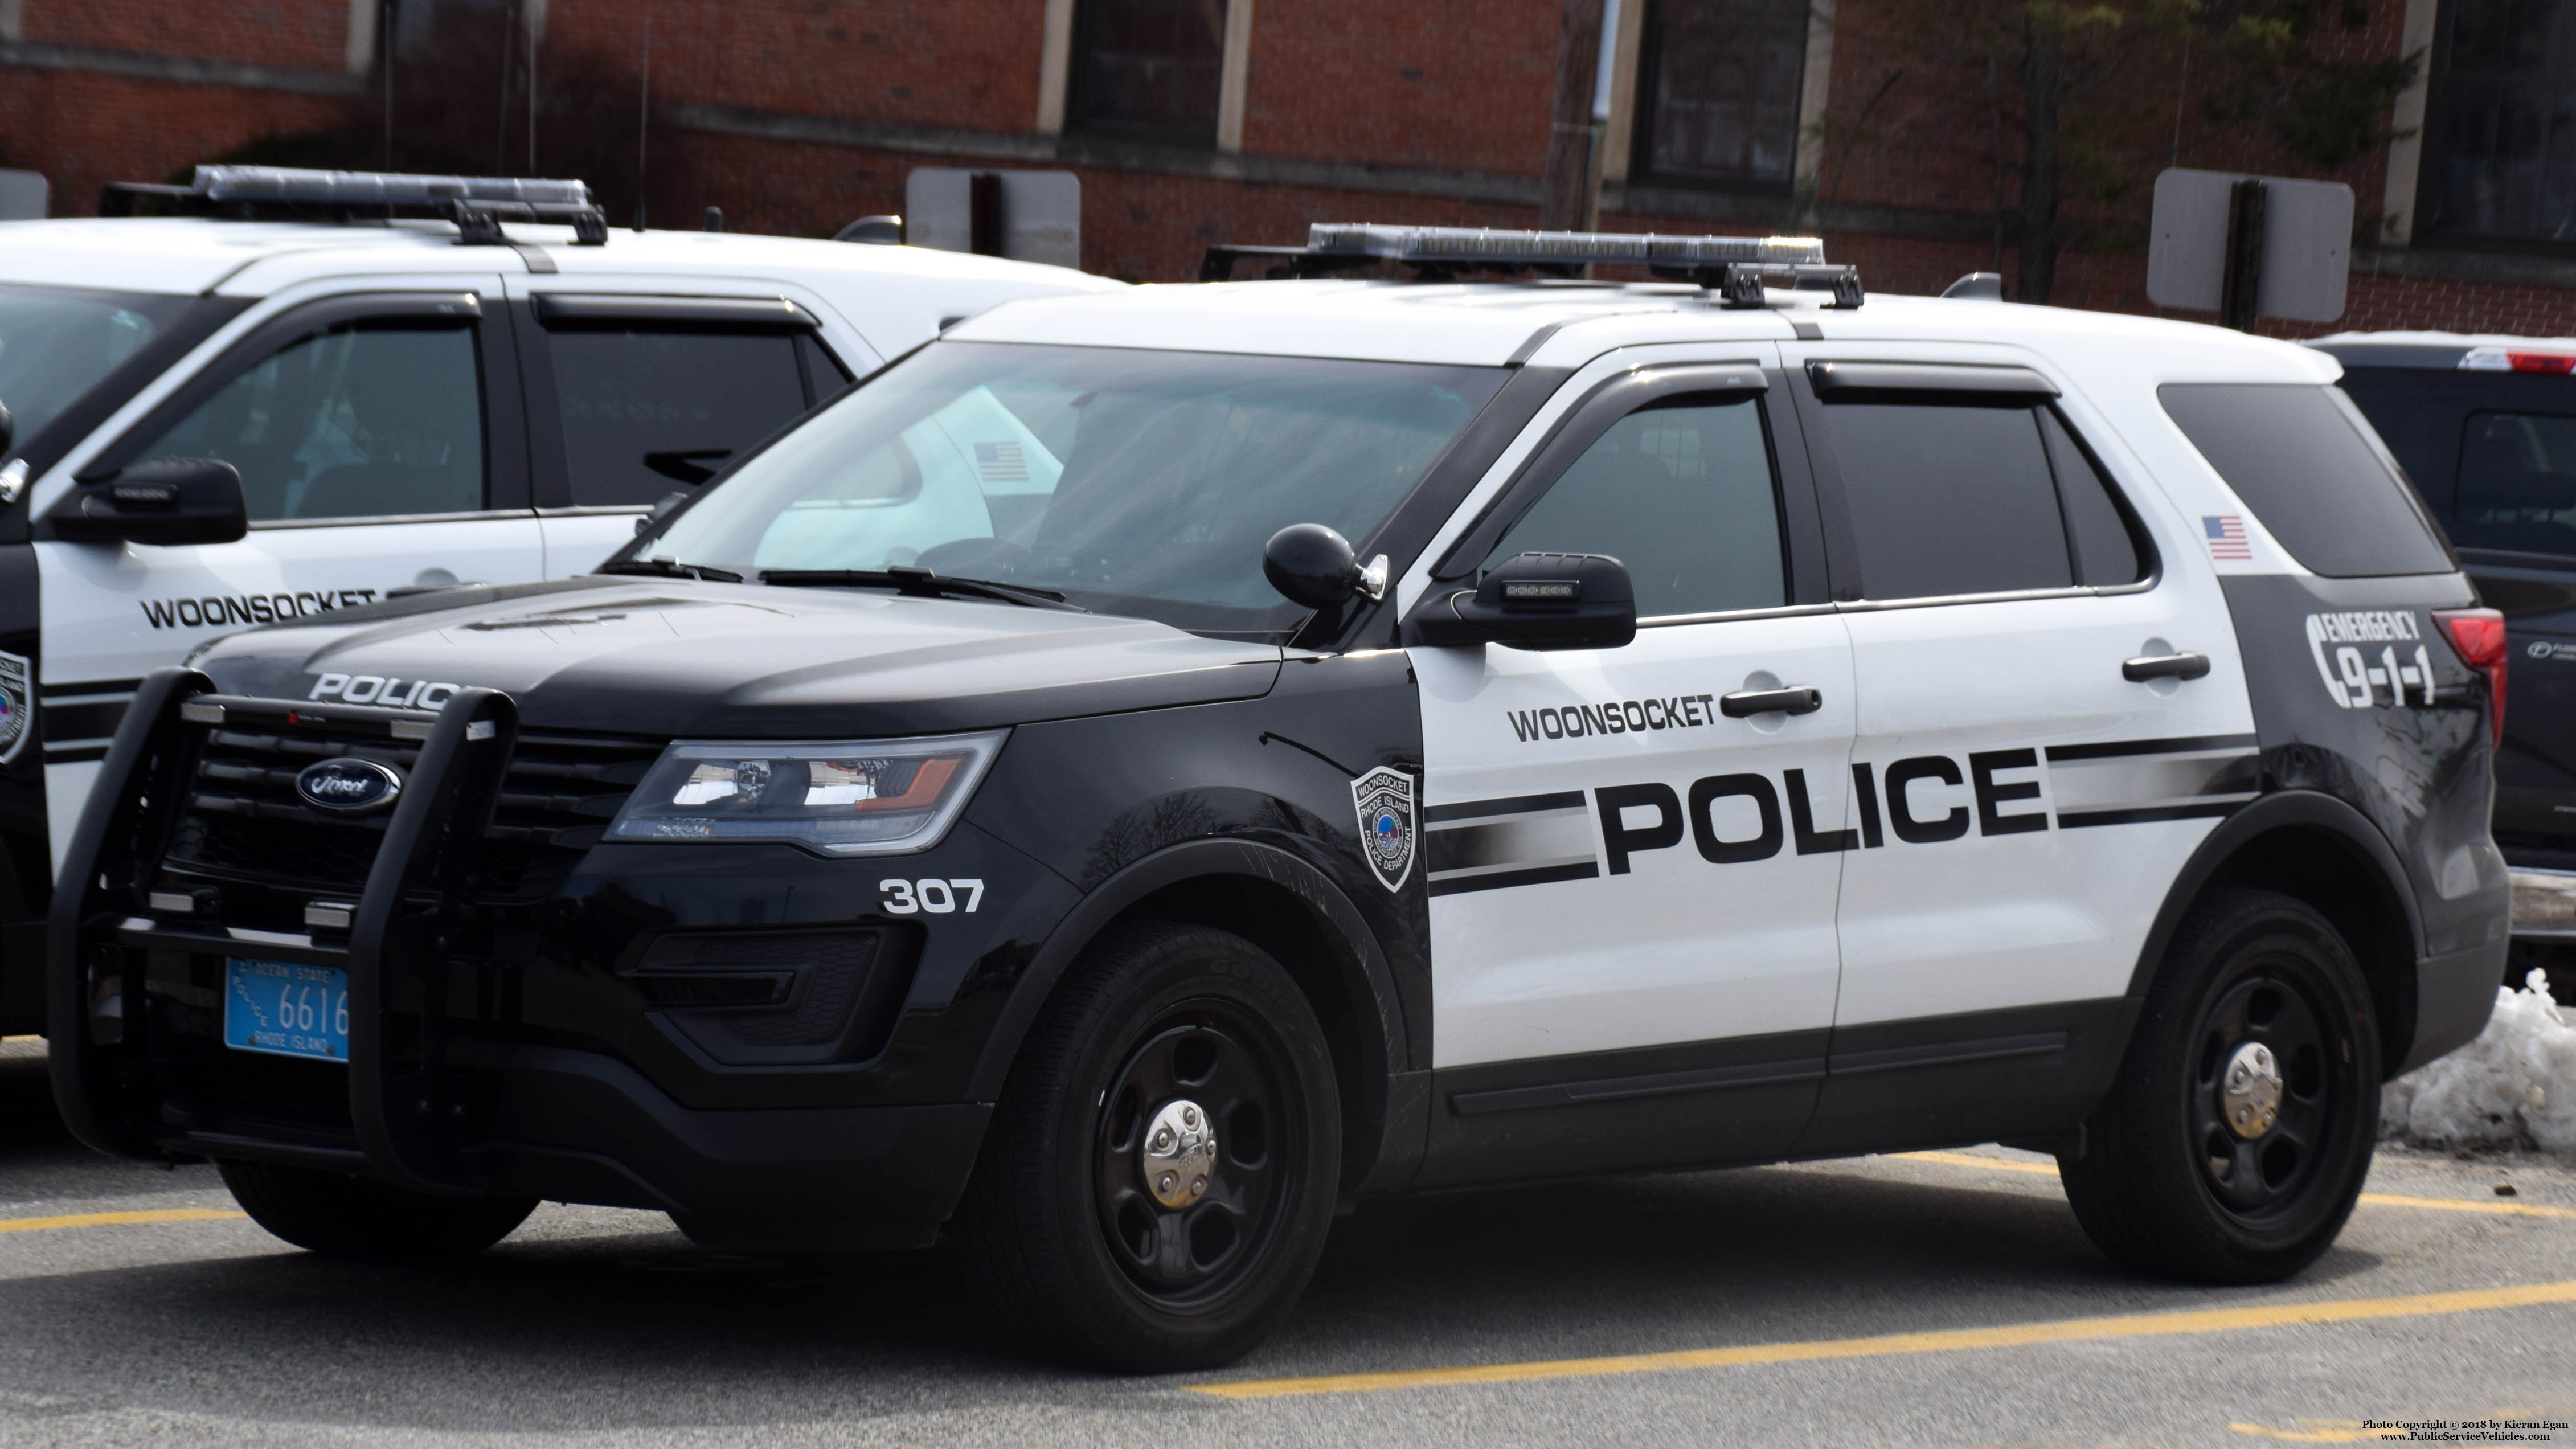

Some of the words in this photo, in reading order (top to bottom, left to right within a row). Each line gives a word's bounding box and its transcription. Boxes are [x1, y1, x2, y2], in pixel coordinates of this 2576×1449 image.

[2321, 610, 2419, 642] EMERGENCY
[308, 673, 460, 710] POLIC
[2336, 644, 2435, 708] 9-1-1
[1508, 694, 1715, 742] WOONSOCKET
[311, 776, 368, 796] Ford
[1358, 775, 1408, 797] WOONSOCKET
[1361, 796, 1382, 818] RHODE
[1384, 796, 1409, 814] ISLAND
[1594, 748, 2048, 875] POLICE
[1365, 830, 1381, 866] POLICE
[1383, 826, 1411, 871] DEPARTMENT
[880, 878, 984, 914] 307
[255, 962, 290, 977] OCEAN
[297, 968, 330, 983] STATE
[279, 984, 348, 1036] 6616
[254, 1030, 287, 1047] RHODE
[292, 1034, 328, 1053] ISLAND
